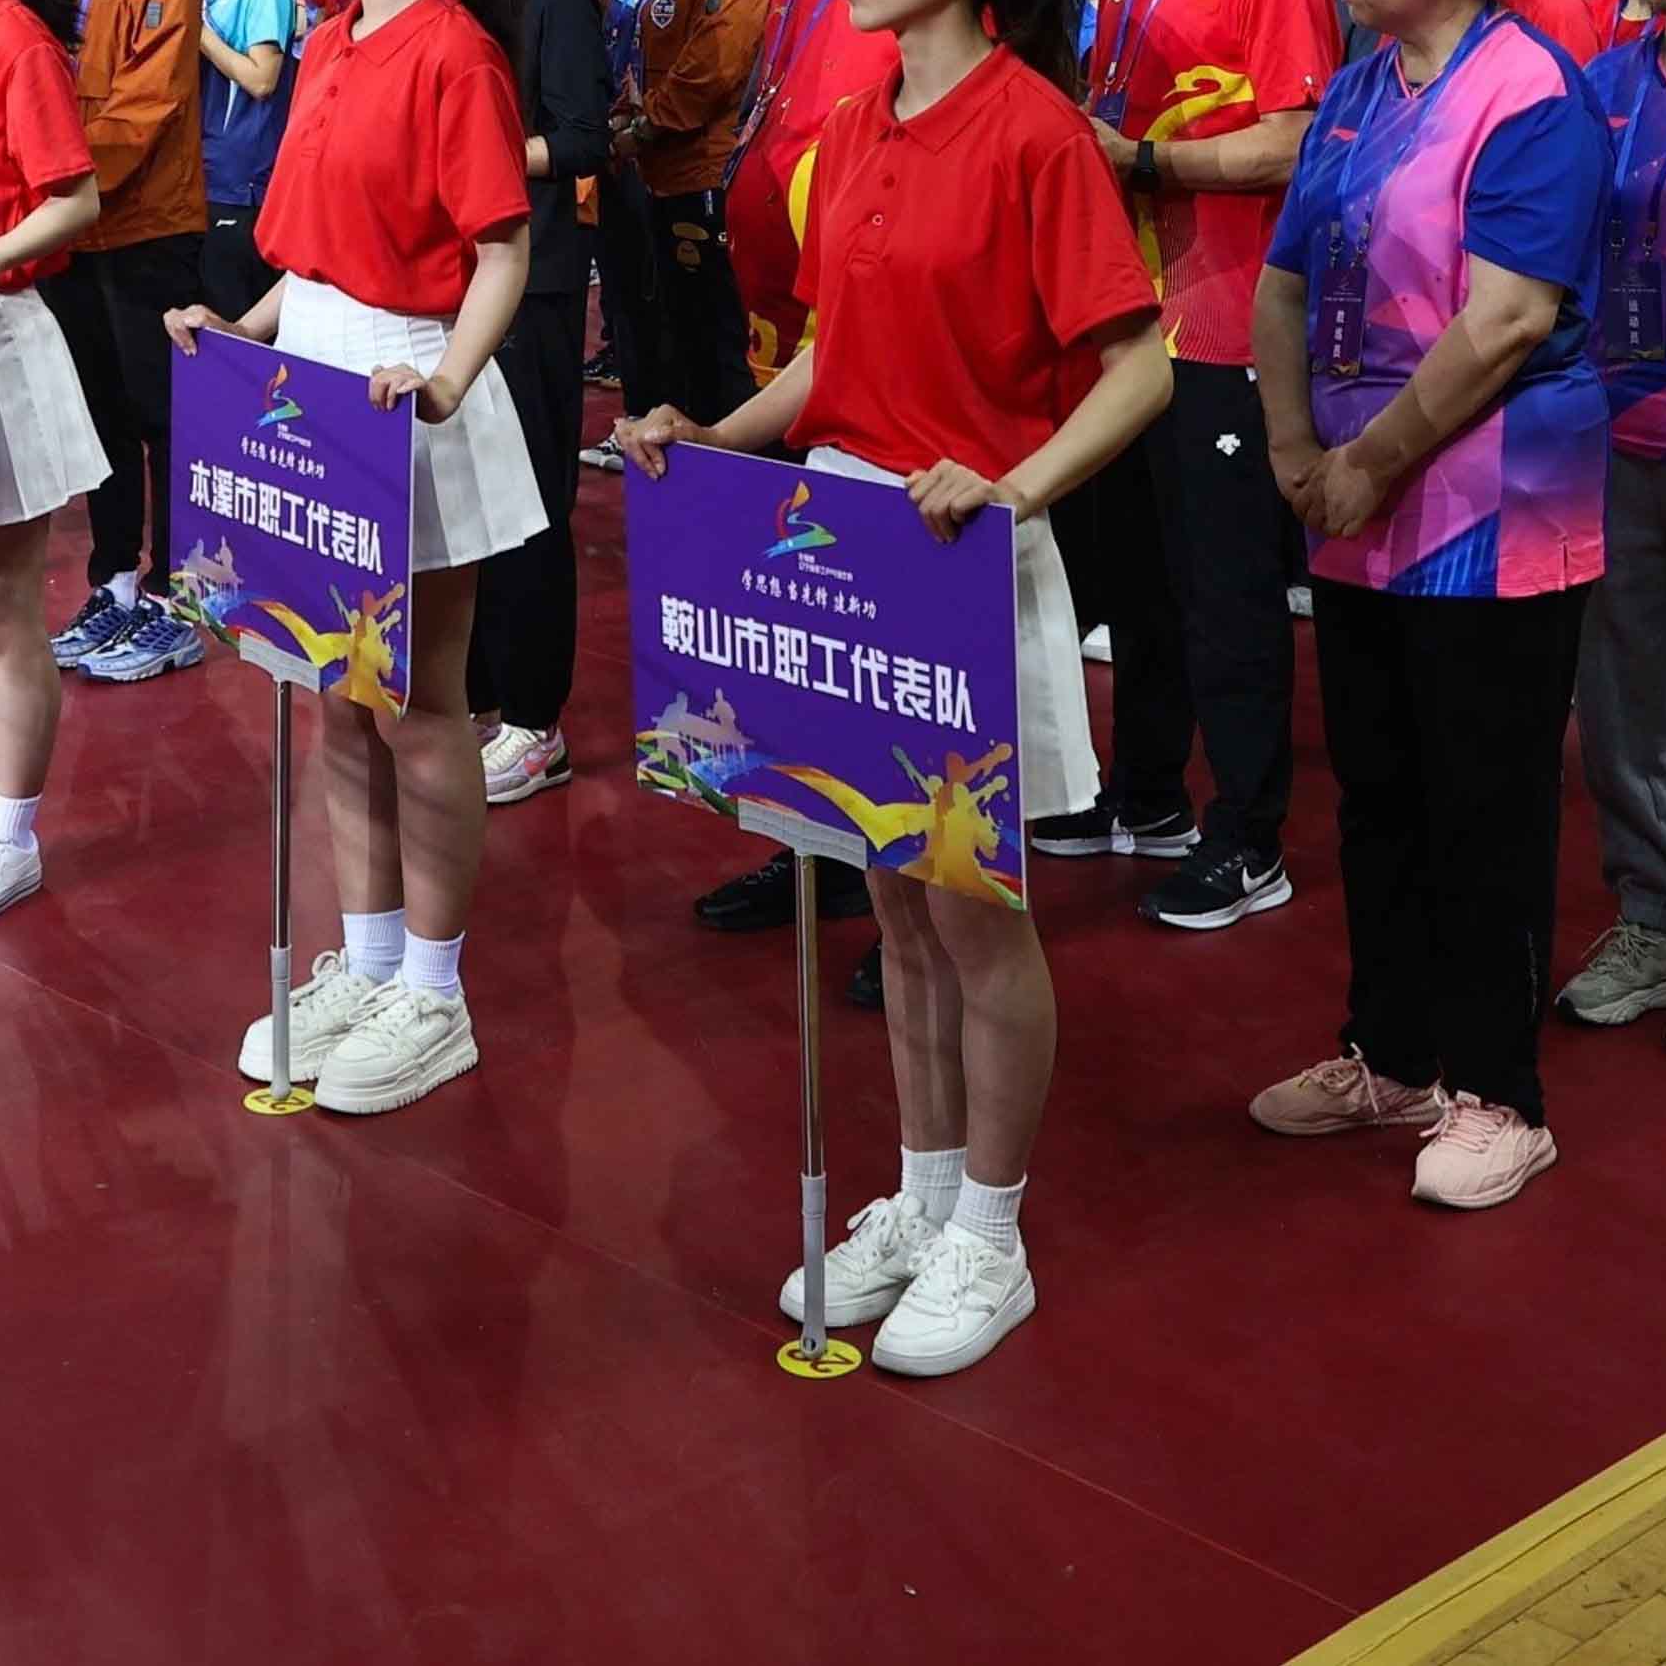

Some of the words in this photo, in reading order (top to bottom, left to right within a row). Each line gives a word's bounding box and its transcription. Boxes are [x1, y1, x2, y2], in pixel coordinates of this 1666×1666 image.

[189, 460, 383, 576] 本溪市职工代表队
[660, 594, 976, 733] 鞍山市职工代表队
